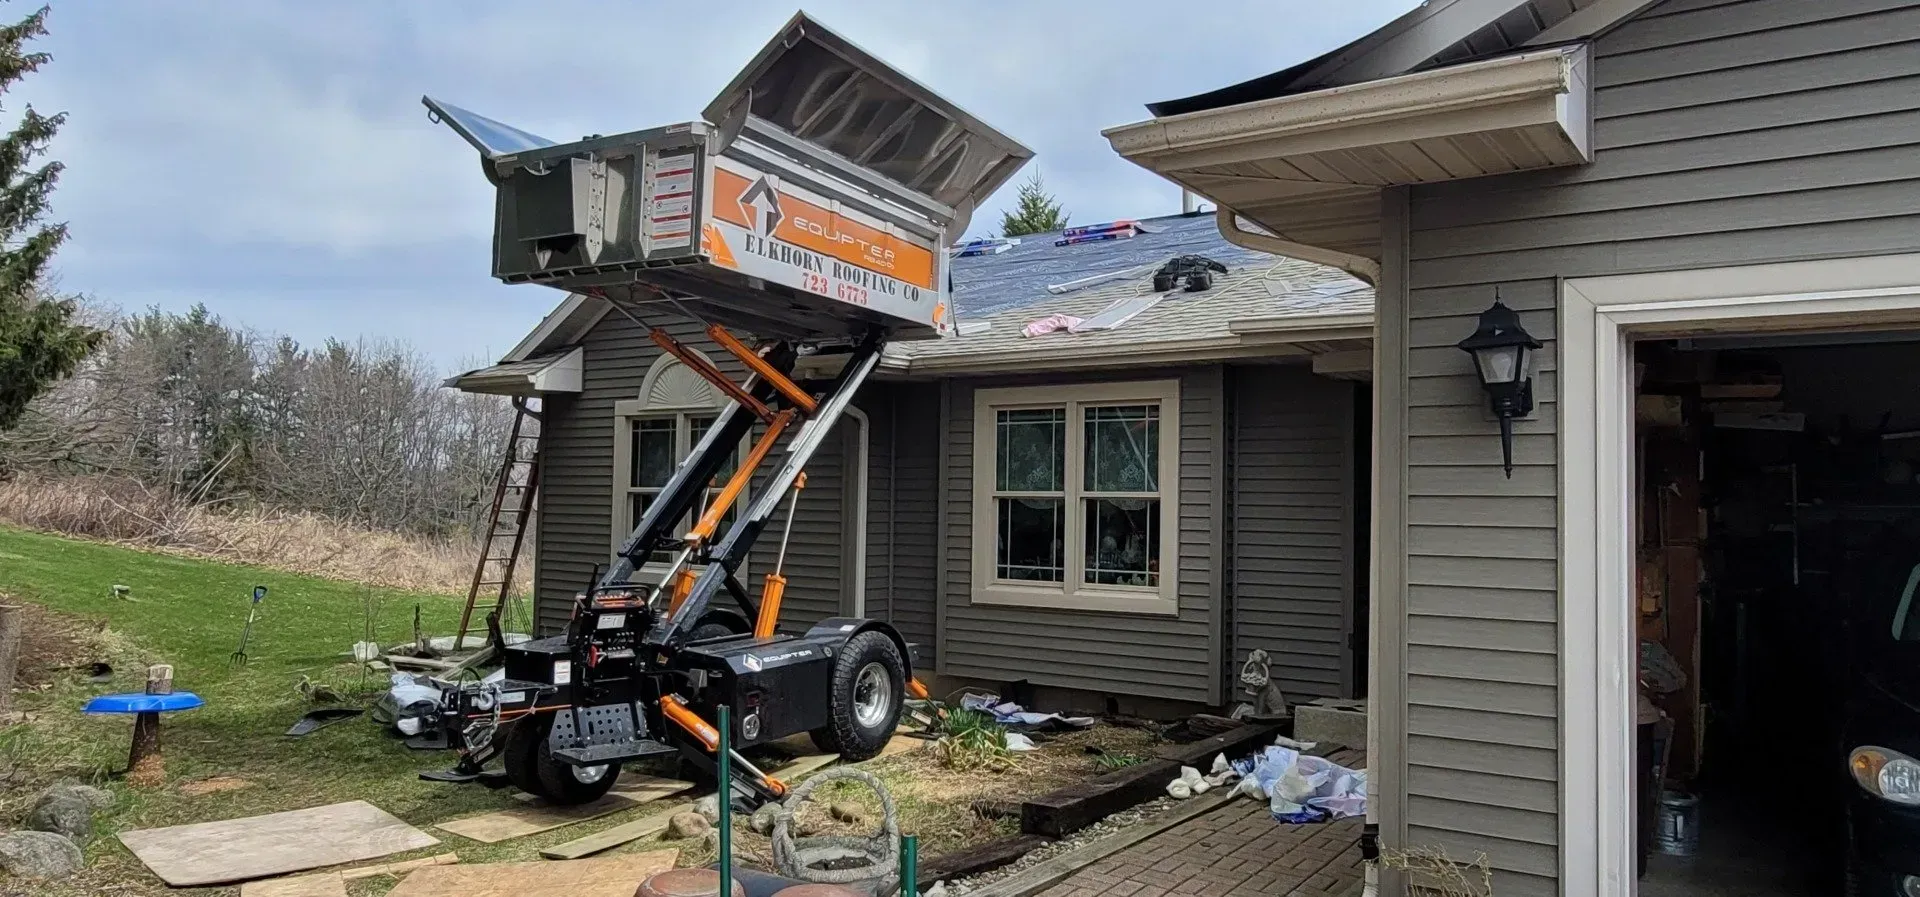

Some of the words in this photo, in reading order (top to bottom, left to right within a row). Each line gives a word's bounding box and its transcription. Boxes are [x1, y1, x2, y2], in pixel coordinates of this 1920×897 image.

[793, 216, 895, 262] EQUIPTER
[745, 233, 824, 274] ELKHORN
[832, 261, 896, 296] ROOFING
[903, 284, 920, 302] CO
[802, 272, 828, 294] 723
[837, 282, 868, 306] 6773
[763, 649, 813, 662] EQUIPTER
